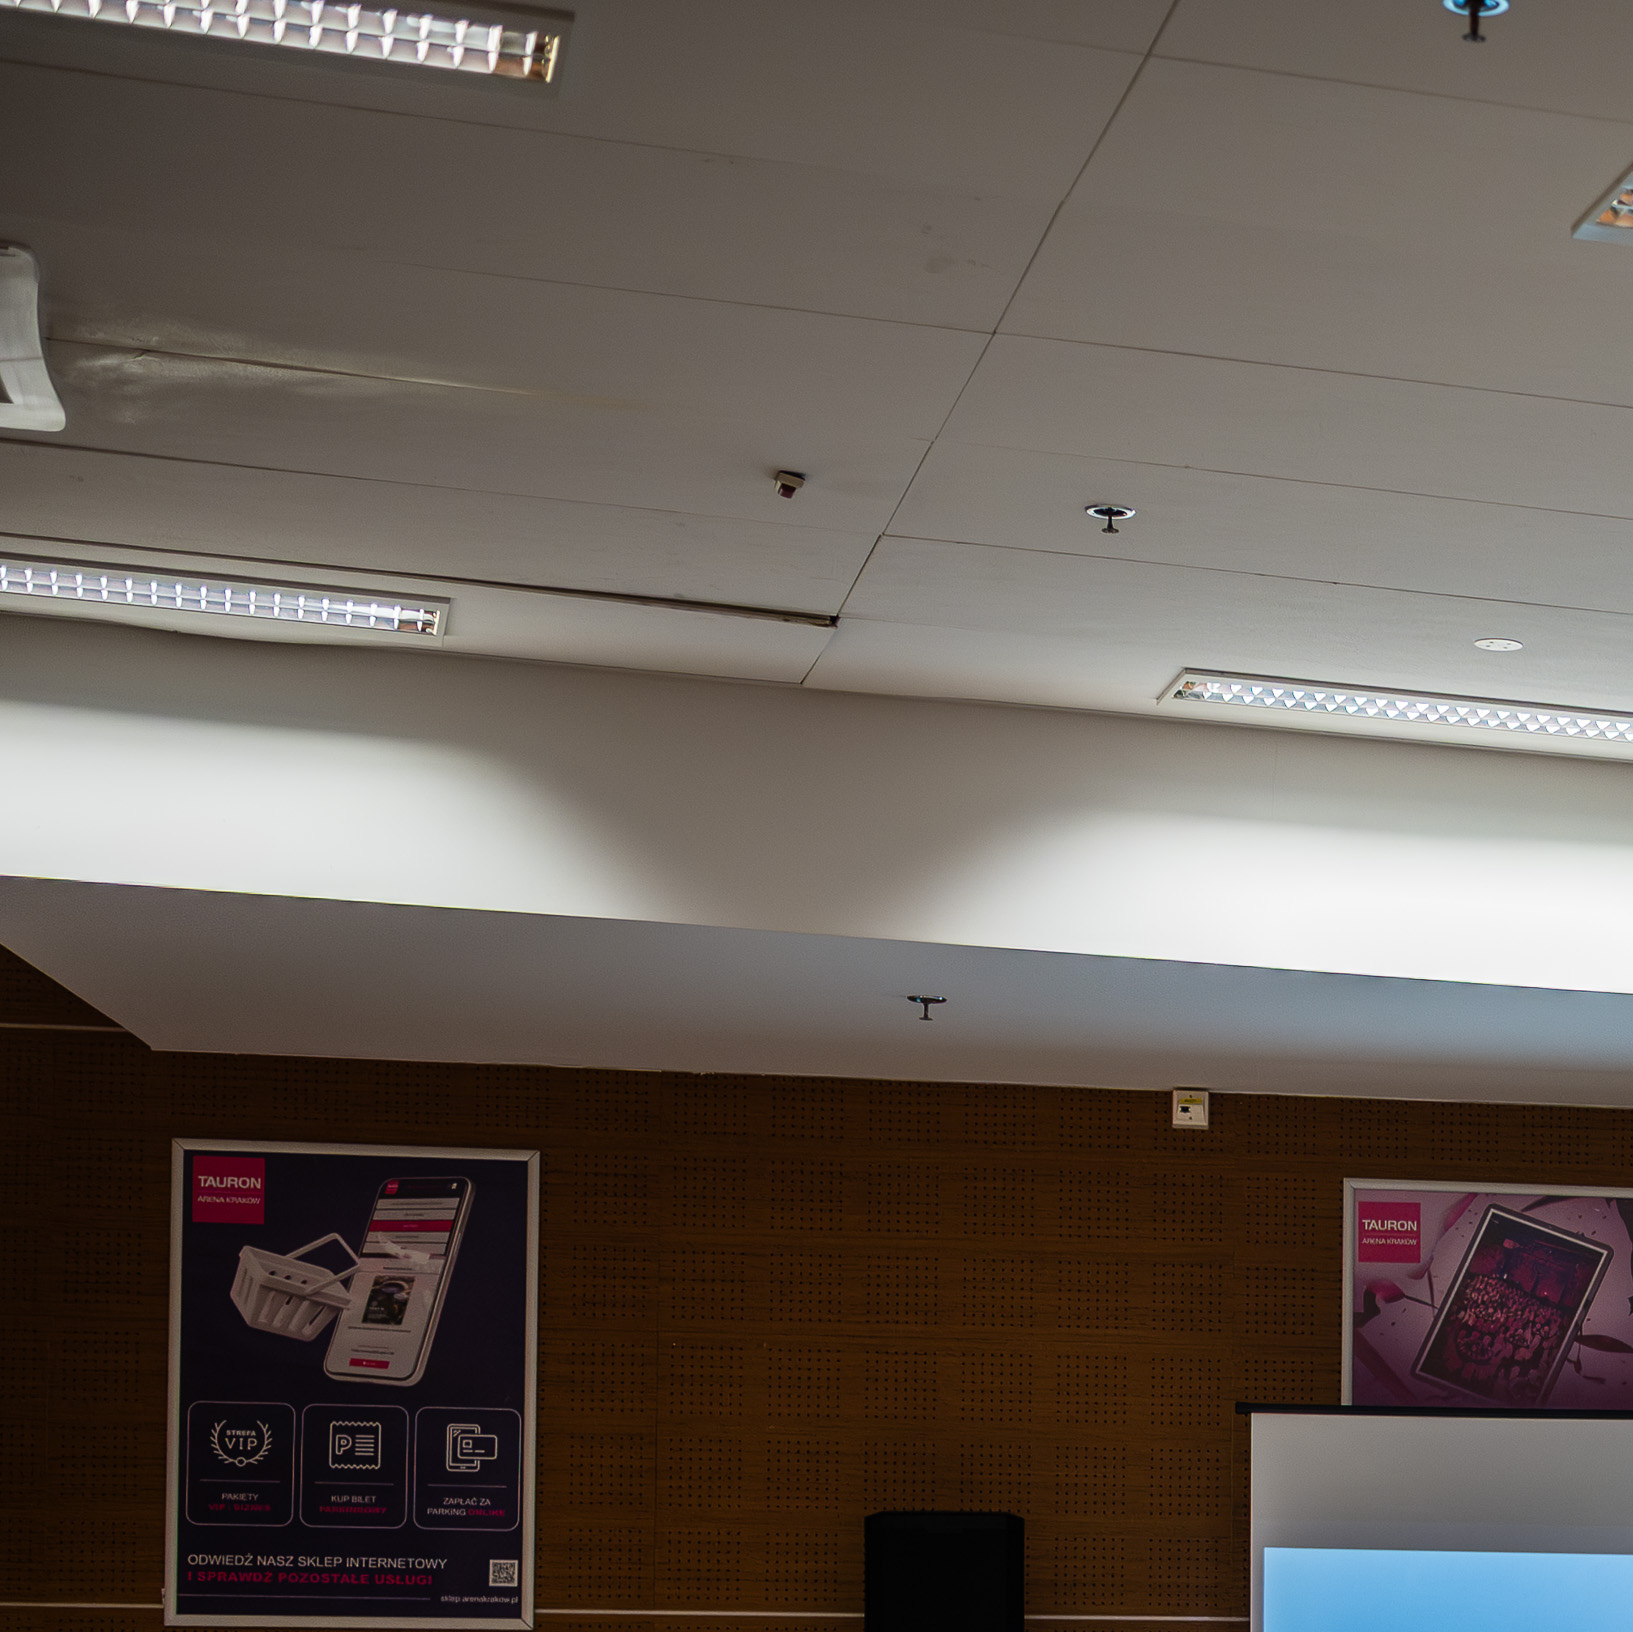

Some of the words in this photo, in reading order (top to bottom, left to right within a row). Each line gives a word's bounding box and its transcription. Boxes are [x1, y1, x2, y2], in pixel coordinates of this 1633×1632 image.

[197, 1175, 261, 1190] TAURON
[197, 1195, 225, 1204] ARENA
[1361, 1219, 1418, 1231] TAURON
[225, 1437, 258, 1451] VIP
[221, 1493, 260, 1502] PAKIETY
[331, 1495, 350, 1503] KUP
[351, 1495, 377, 1504] BILET
[479, 1497, 492, 1507] ZA
[427, 1507, 467, 1517] PARKING
[257, 1555, 295, 1567] NASZ
[297, 1556, 343, 1568] SKLEP
[346, 1557, 448, 1570] INTERNETOWY
[278, 1572, 370, 1585] POZOSTAŁE
[374, 1574, 433, 1586] USŁUGI
